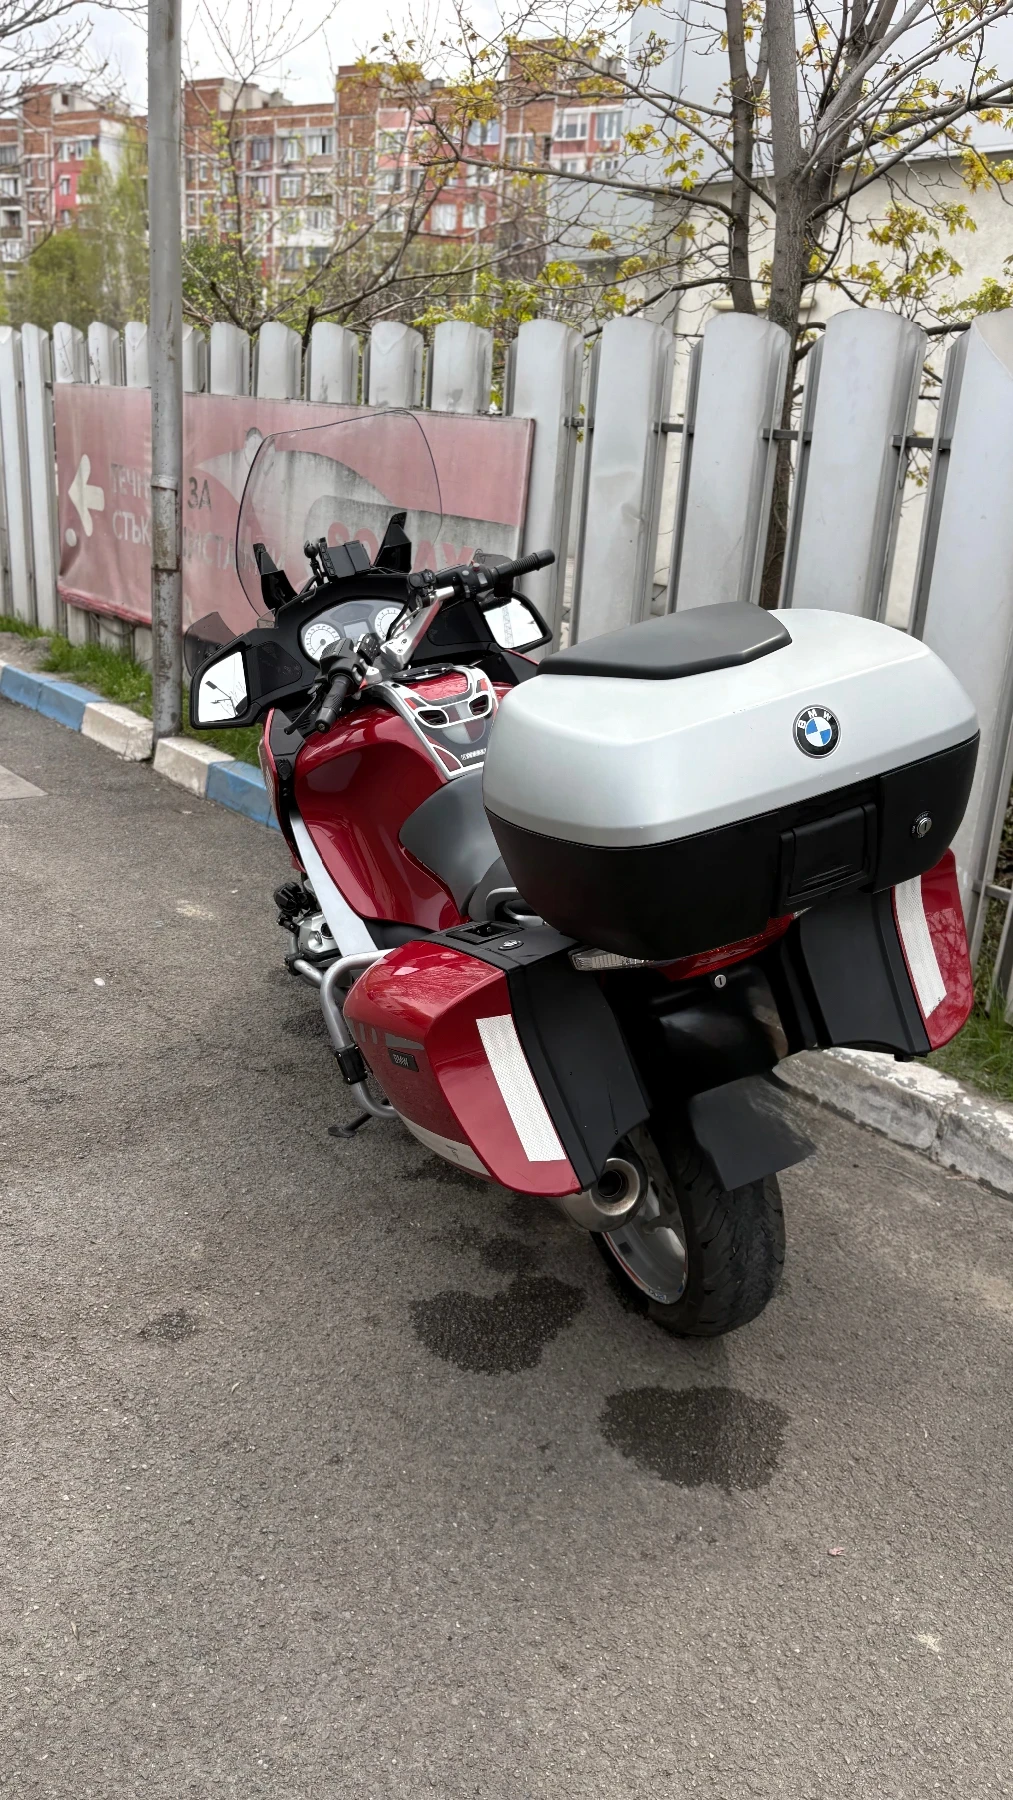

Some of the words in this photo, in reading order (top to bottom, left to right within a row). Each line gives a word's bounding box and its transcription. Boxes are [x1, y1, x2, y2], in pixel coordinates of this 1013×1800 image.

[111, 463, 151, 500] ТЕЧН
[187, 476, 213, 512] ЗА
[798, 709, 832, 729] BMW
